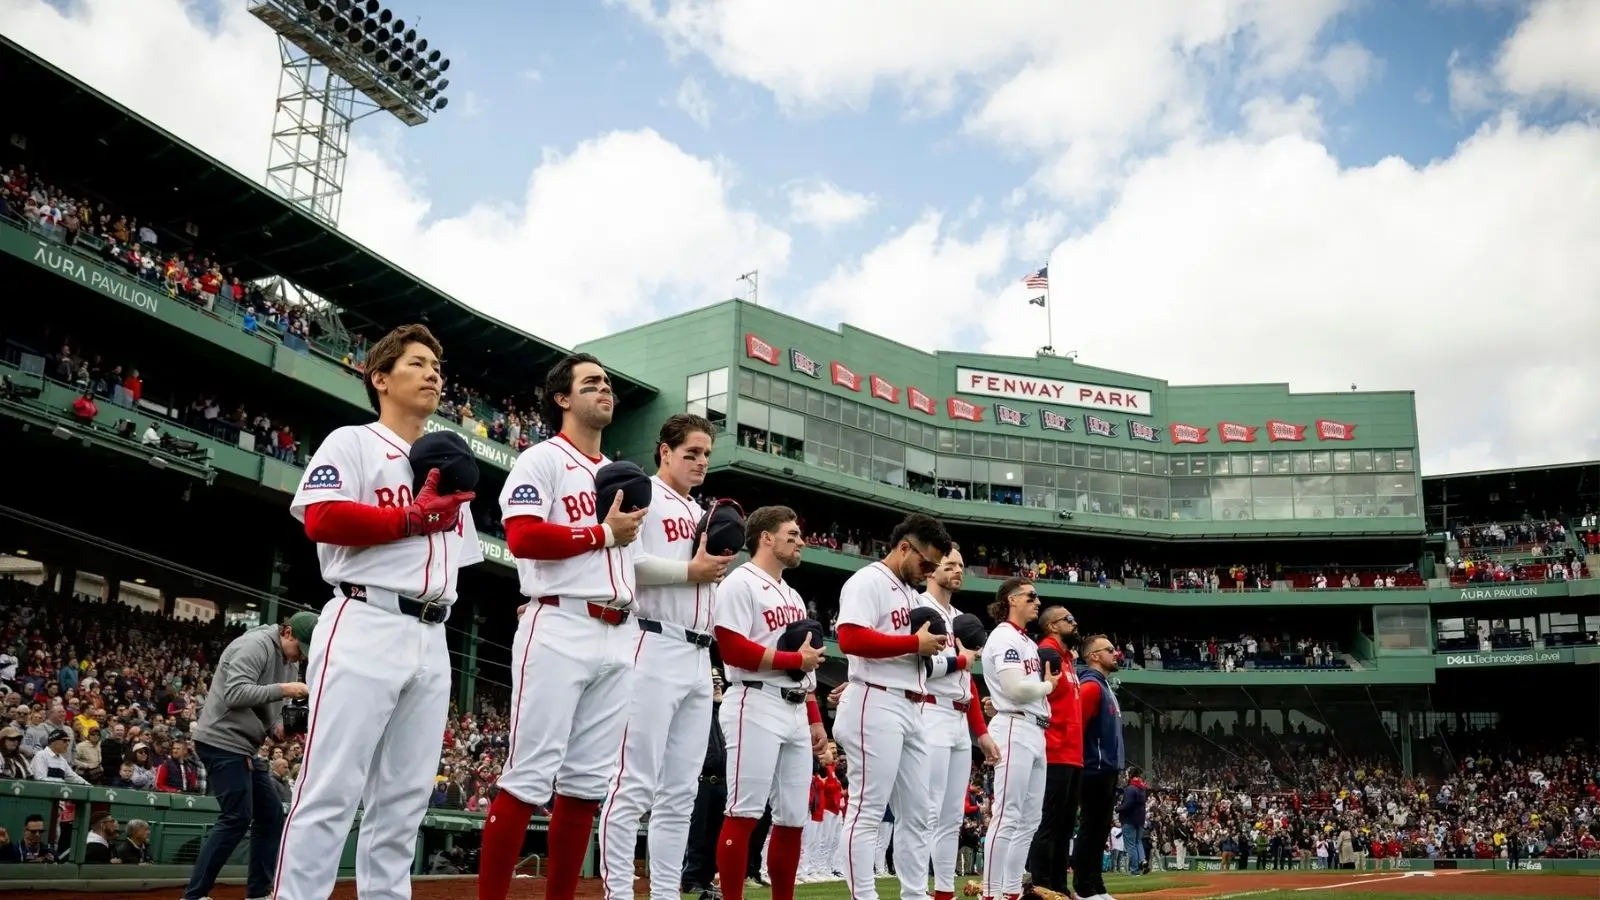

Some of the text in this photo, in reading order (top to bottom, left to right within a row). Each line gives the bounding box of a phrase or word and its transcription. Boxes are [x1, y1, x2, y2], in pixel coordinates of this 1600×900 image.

[91, 271, 158, 313] PAVILION
[971, 375, 1138, 408] FENWAY PARK
[471, 439, 508, 465] FENWAY
[1494, 587, 1537, 598] PAVILION
[1536, 651, 1560, 661] Level
